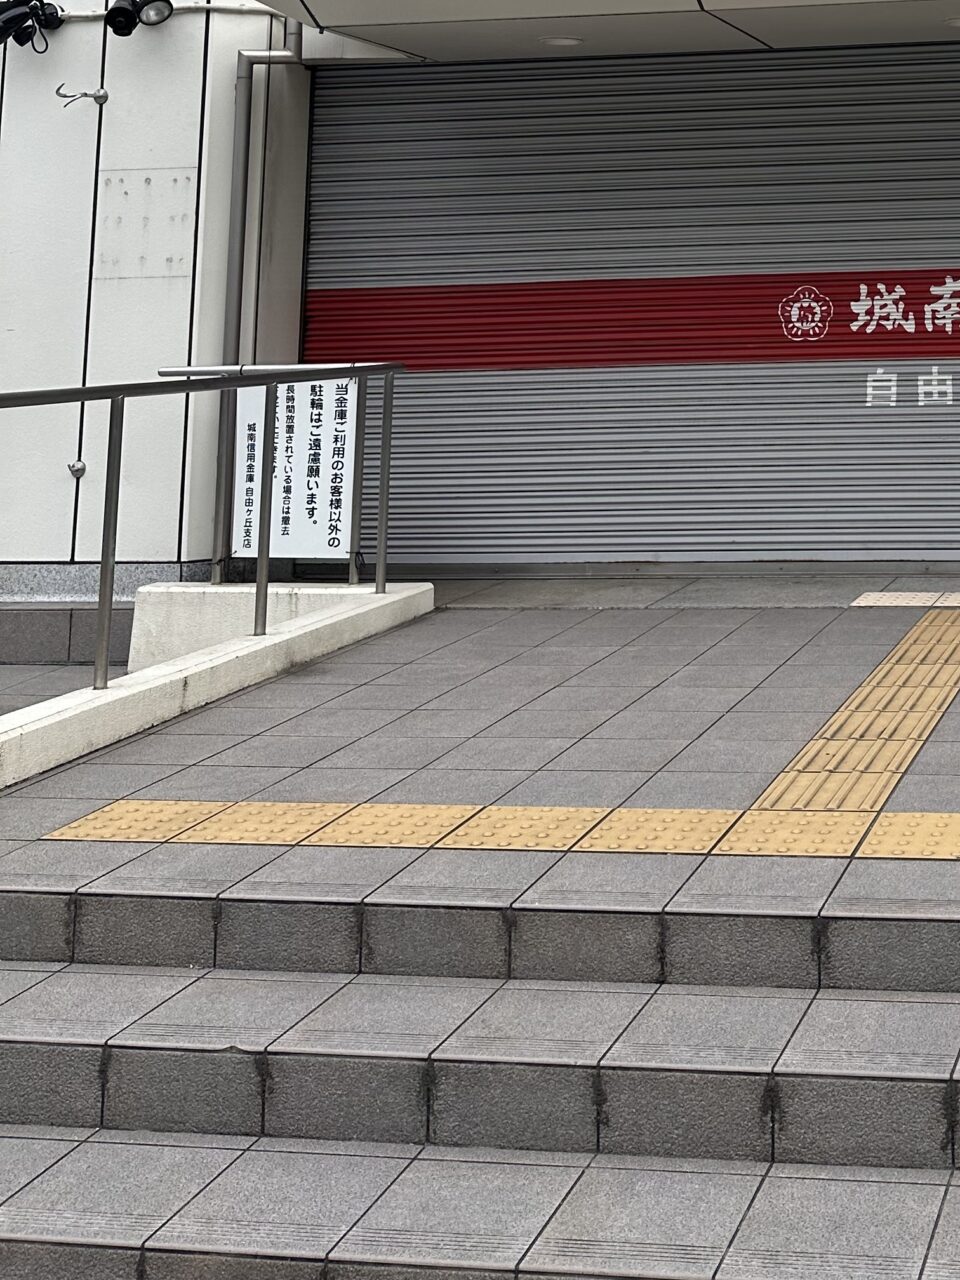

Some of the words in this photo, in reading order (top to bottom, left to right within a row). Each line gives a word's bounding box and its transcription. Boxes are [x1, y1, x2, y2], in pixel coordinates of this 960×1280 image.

[245, 423, 256, 483] 城南信用金庫
[281, 385, 295, 536] 長時間放置されている場合は撤去
[305, 384, 324, 525] 駐輪はご遠慮願います。
[328, 383, 349, 548] 当金庫ご利用のお客様以外の
